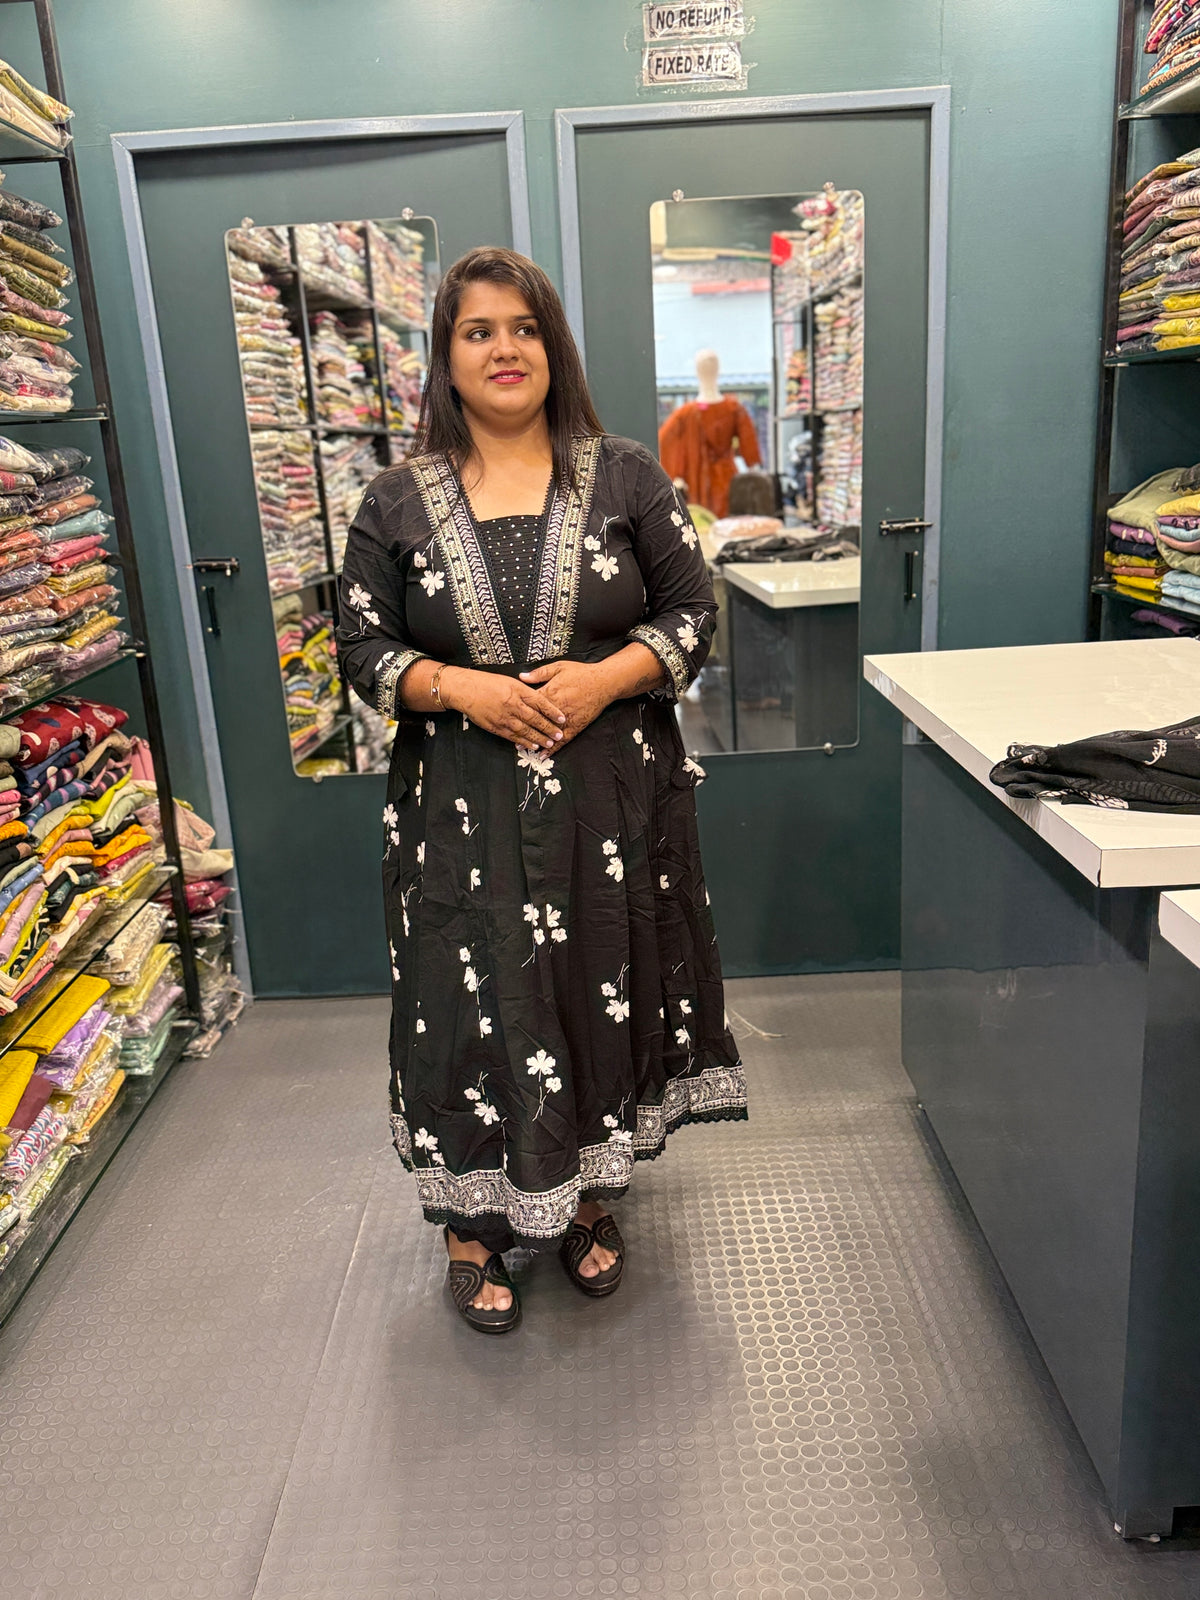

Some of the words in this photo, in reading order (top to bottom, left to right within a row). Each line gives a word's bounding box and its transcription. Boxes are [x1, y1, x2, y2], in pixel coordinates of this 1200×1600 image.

[656, 10, 675, 29] NO
[679, 7, 731, 28] REFUND
[655, 56, 693, 75] FIXED
